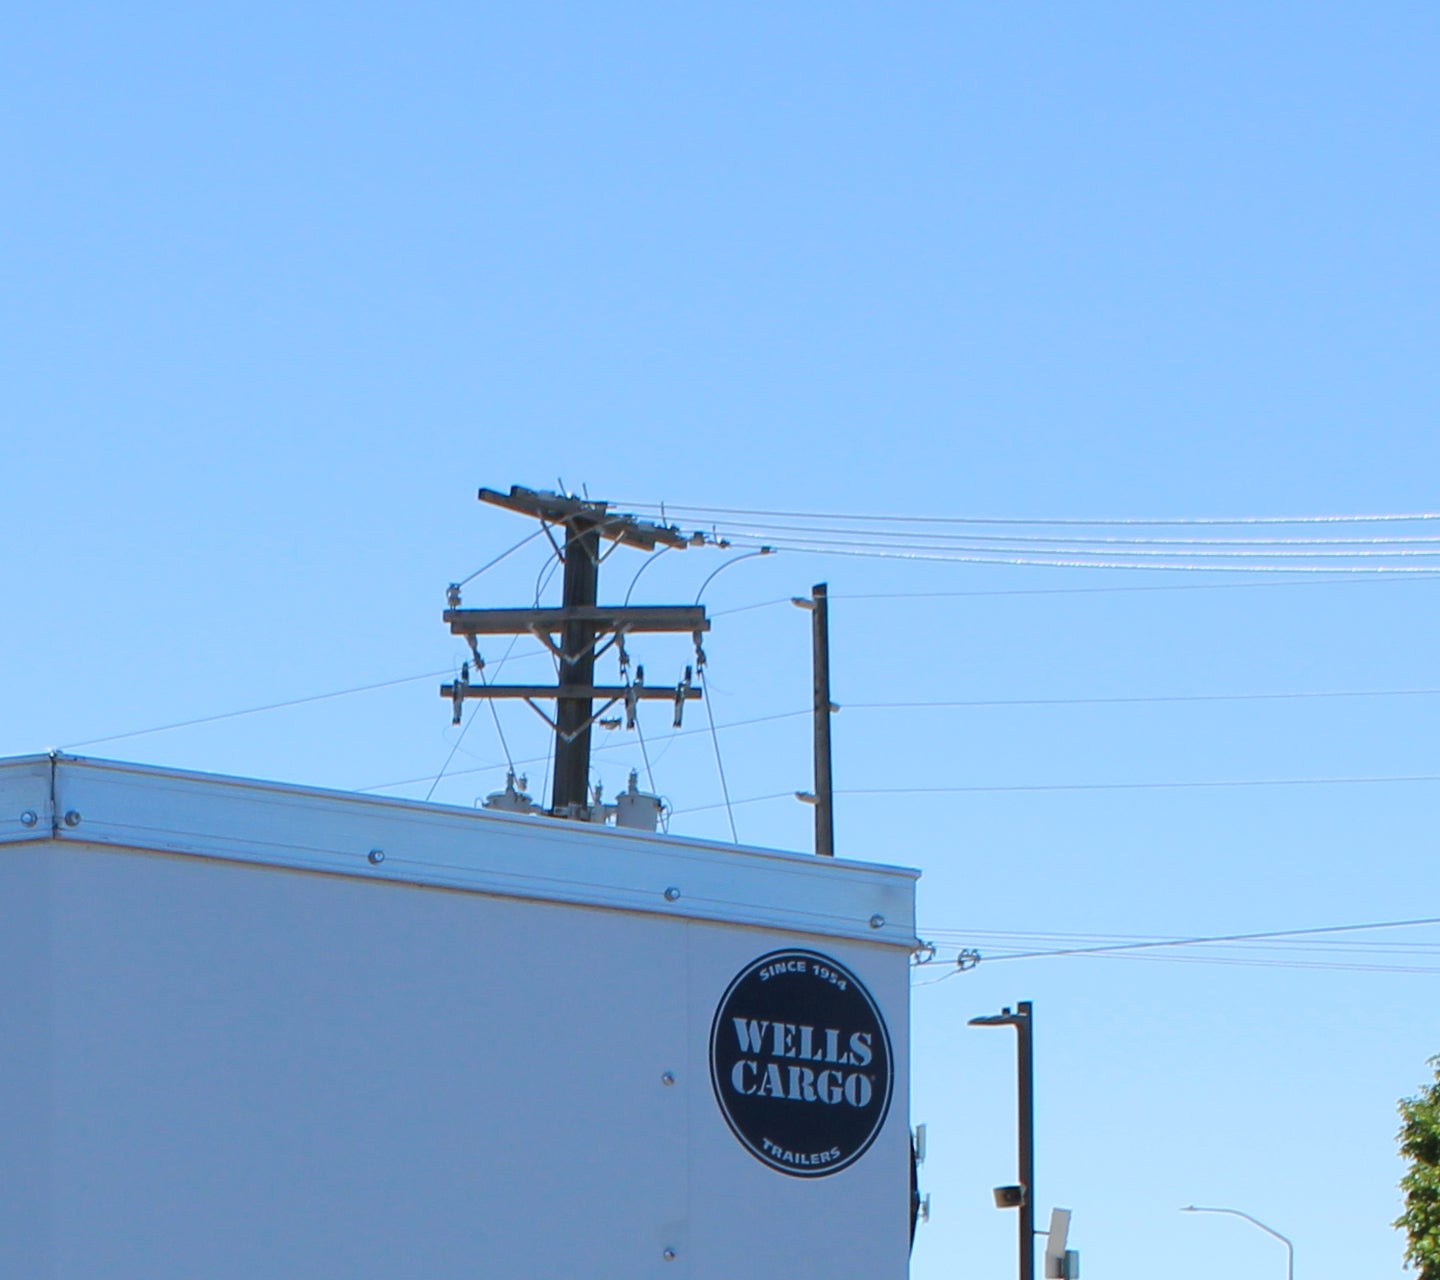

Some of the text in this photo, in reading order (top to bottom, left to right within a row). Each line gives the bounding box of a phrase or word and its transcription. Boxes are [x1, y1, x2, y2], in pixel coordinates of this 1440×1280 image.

[759, 960, 848, 992] SINCE 1954
[731, 1016, 873, 1067] WELLS
[730, 1060, 872, 1108] CARGO
[760, 1136, 841, 1165] TRAILERS
